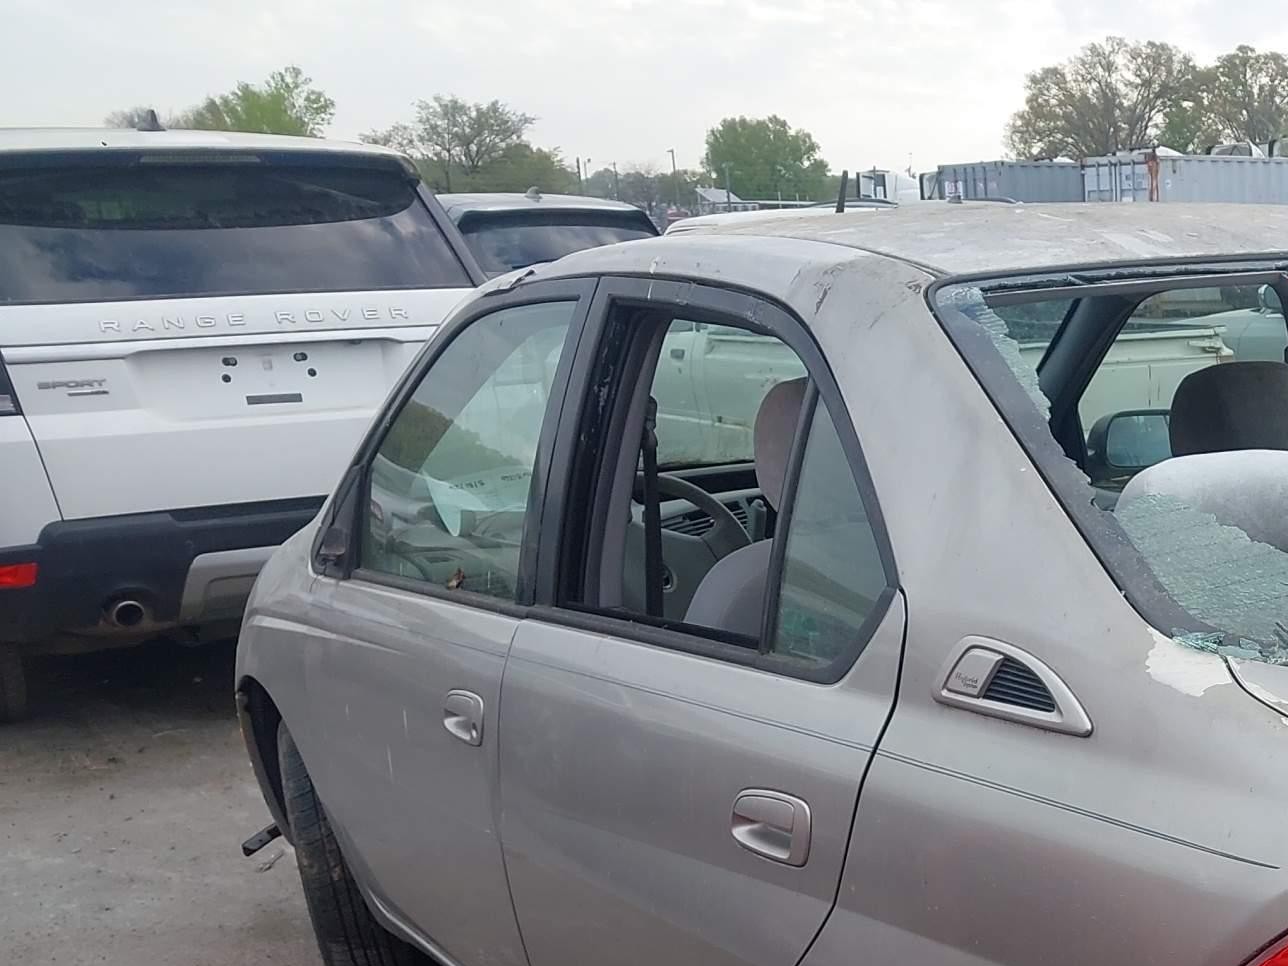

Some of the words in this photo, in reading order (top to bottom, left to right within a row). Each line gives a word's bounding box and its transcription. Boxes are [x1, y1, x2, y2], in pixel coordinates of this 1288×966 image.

[99, 312, 248, 334] RANGE
[273, 305, 410, 325] ROVER
[37, 379, 106, 390] SPORT
